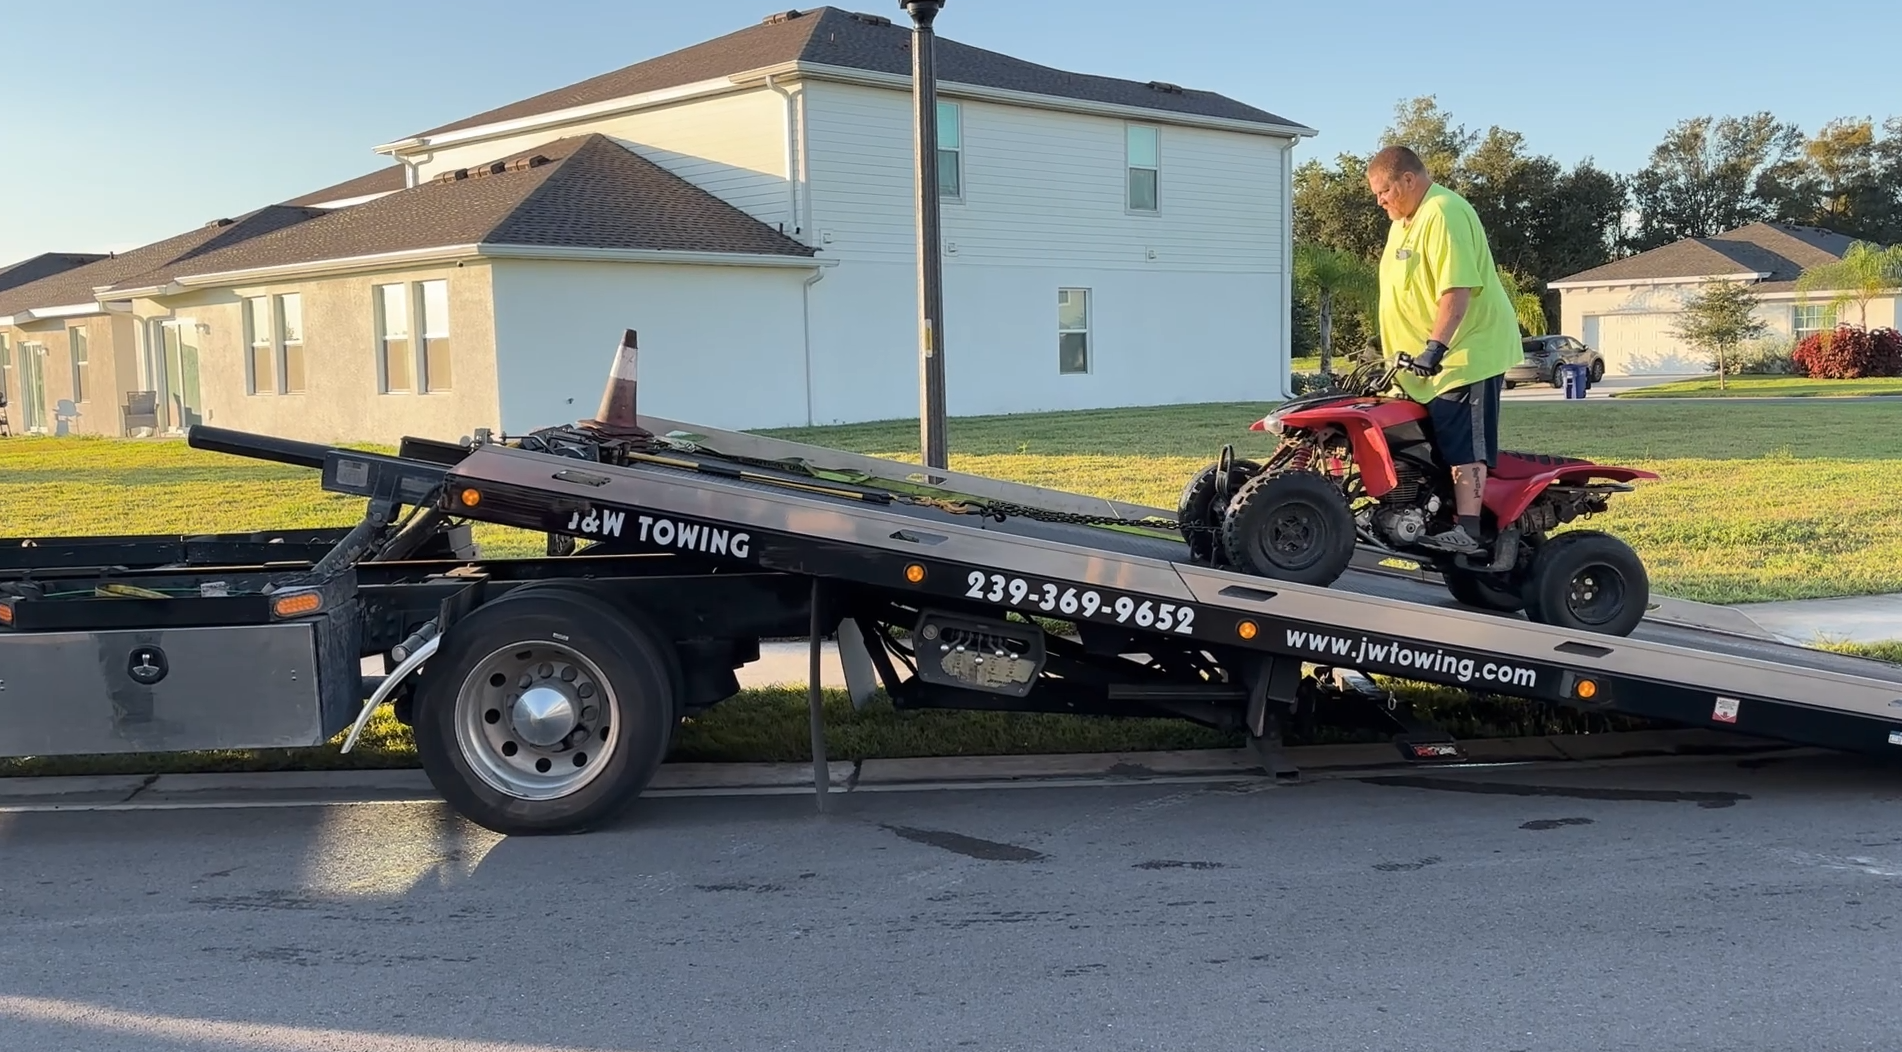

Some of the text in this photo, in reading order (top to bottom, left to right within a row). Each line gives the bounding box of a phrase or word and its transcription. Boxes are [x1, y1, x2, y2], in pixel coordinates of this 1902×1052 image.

[568, 507, 750, 558] J&W TOWING
[965, 571, 1195, 635] 239-369-9652
[1286, 629, 1536, 688] www.jwtowing.com
